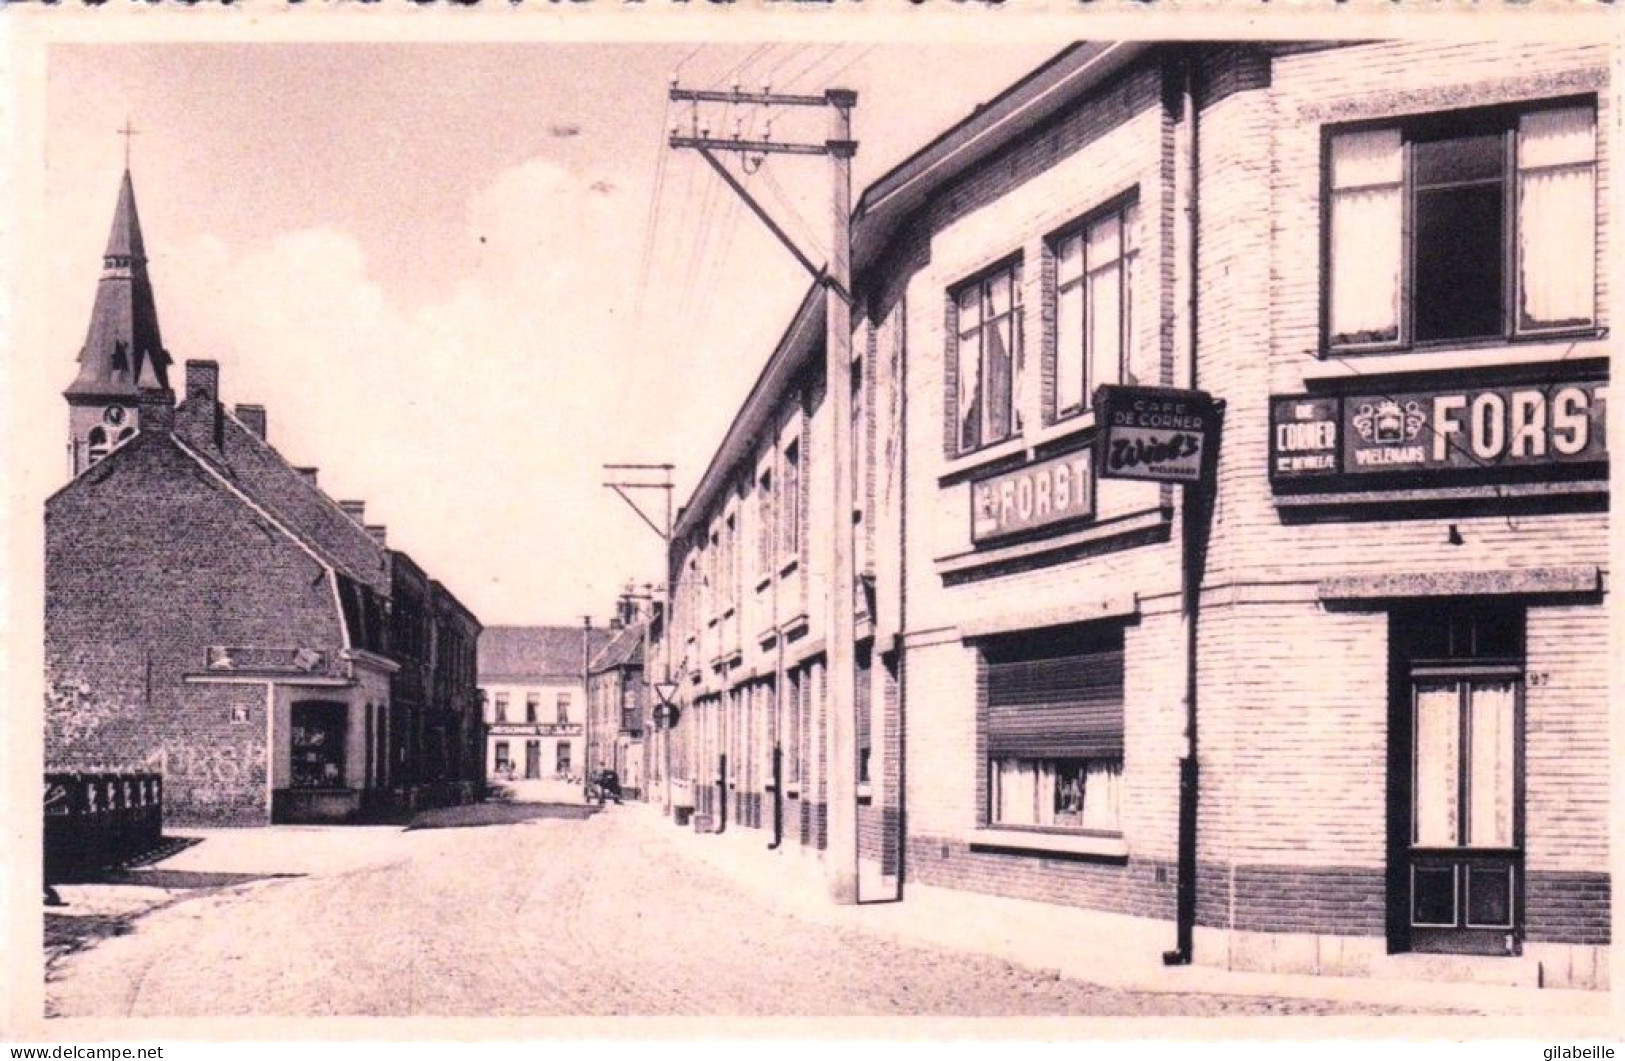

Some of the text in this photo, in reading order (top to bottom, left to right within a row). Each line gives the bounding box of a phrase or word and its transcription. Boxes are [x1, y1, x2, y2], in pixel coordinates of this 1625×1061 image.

[1114, 411, 1202, 428] DE CORNER
[1001, 458, 1089, 527] FORST
